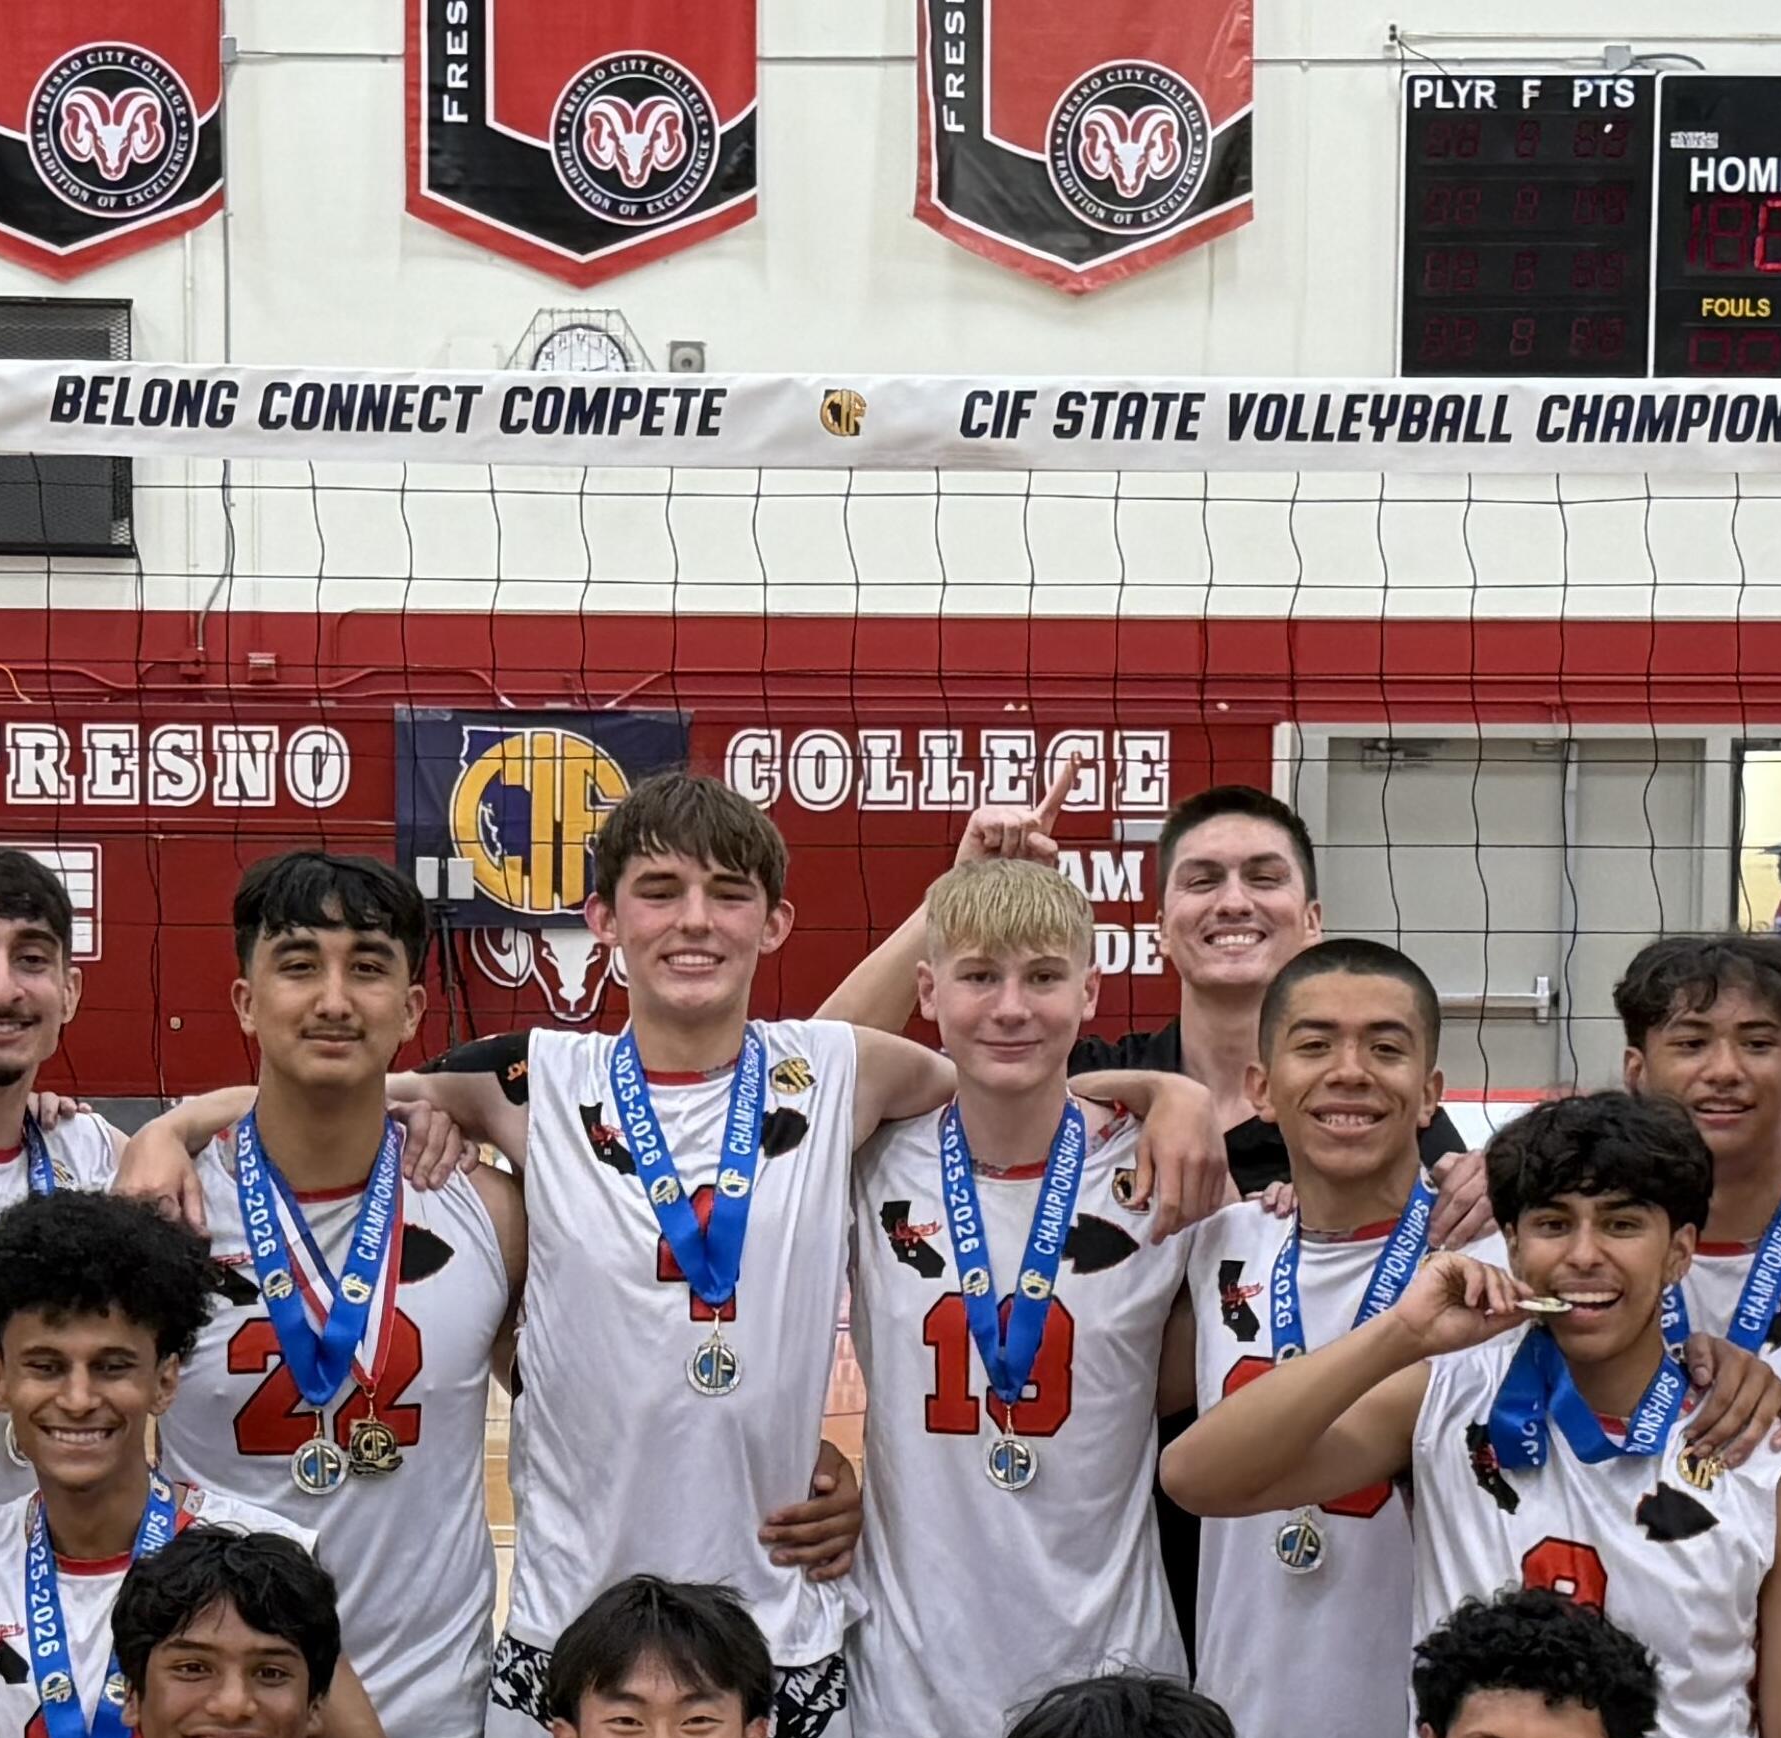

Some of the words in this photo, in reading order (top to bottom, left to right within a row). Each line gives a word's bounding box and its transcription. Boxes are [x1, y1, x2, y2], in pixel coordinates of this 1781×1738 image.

[38, 60, 82, 113] FRESNO
[88, 52, 124, 65] CITY
[131, 55, 185, 117] COLLEGE
[561, 69, 605, 122] FRESNO
[610, 61, 647, 74] CITY
[653, 64, 708, 126] COLLEGE
[942, 0, 966, 133] FRES
[1057, 77, 1101, 131] FRESNO
[1107, 70, 1142, 83] CITY
[1149, 73, 1201, 135] COLLEGE
[1413, 80, 1496, 108] PLYR
[1522, 80, 1542, 108] F
[1573, 80, 1636, 108] PTS
[35, 131, 90, 200] TRADITION
[100, 194, 118, 206] OF
[128, 130, 189, 205] EXCELLENCE
[558, 140, 610, 209] TRADITION
[620, 203, 638, 215] OF
[646, 139, 709, 214] EXCELLENCE
[1055, 149, 1106, 217] TRADITION
[1116, 211, 1133, 224] OF
[1143, 148, 1202, 222] EXCELLENCE
[1702, 298, 1771, 318] FOULS
[51, 376, 238, 430] BELONG
[259, 382, 483, 434] CONNECT
[500, 387, 726, 437] COMPETE
[960, 391, 1037, 439] CIF
[1053, 392, 1205, 441] STATE
[1229, 394, 1511, 443] VOLLEYBALL
[725, 728, 1170, 812] COLLEGE
[1057, 851, 1144, 902] AM
[616, 1046, 661, 1166] 2025-2026
[729, 1034, 760, 1155] CHAMPIONSHIPS
[237, 1125, 277, 1257] 2025-2026
[356, 1125, 399, 1261] CHAMPIONSHIPS
[941, 1118, 980, 1254] 2025-2026
[1034, 1118, 1081, 1255] CHAMPIONSHIPS
[227, 1307, 423, 1455] 22
[29, 1516, 60, 1658] 2025-2026
